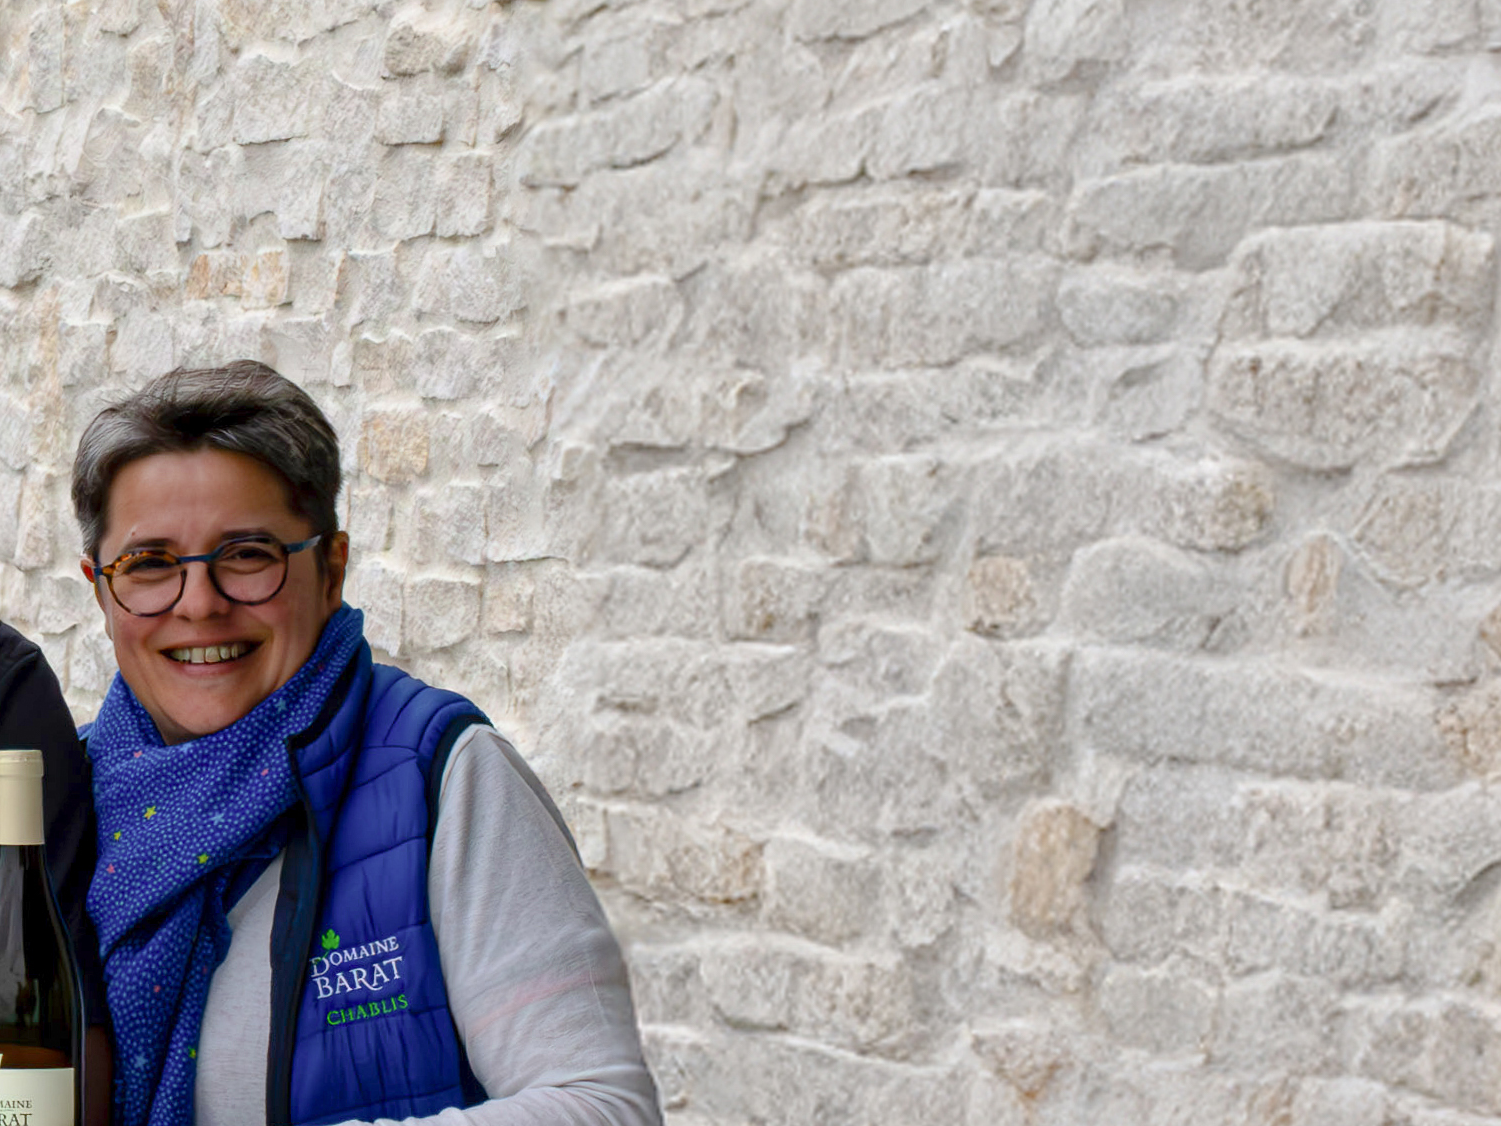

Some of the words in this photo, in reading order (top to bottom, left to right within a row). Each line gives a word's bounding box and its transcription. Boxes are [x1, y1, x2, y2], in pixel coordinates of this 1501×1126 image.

[309, 936, 399, 978] DOMAINE
[312, 956, 403, 999] BARAT
[326, 994, 408, 1025] CHABLIS
